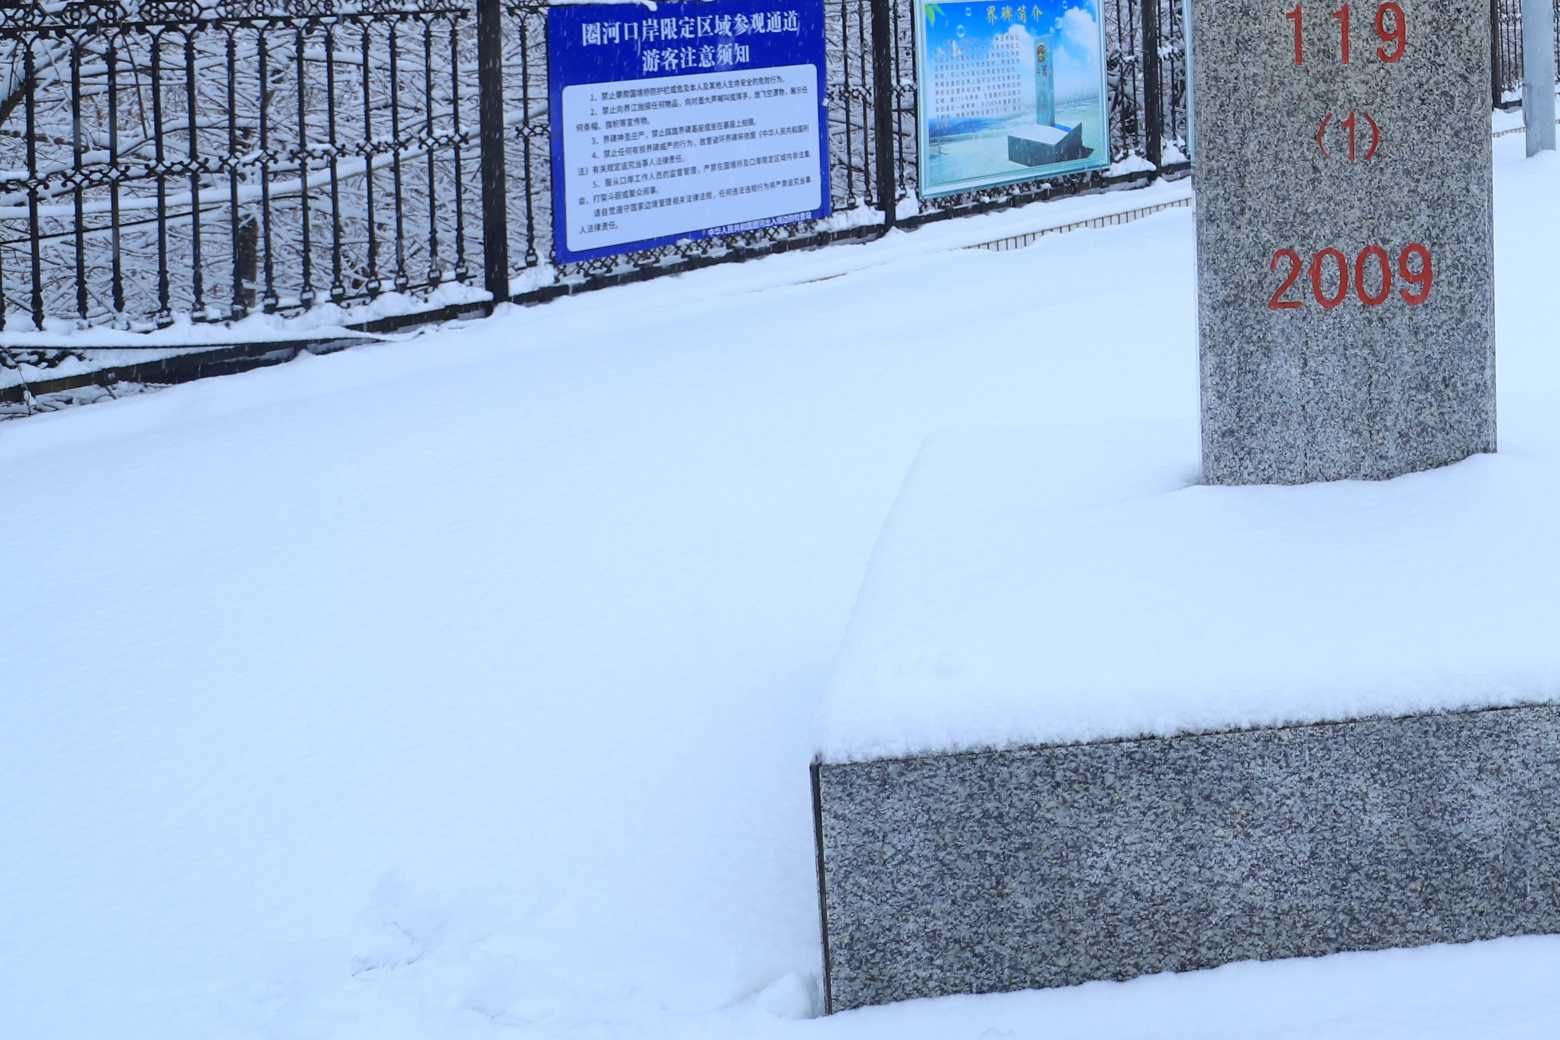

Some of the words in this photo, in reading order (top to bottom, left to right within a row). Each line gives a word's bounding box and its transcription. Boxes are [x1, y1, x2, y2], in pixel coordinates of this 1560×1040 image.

[582, 10, 799, 47] 圈河口岸限定区域参观通道
[1285, 1, 1406, 65] 119
[642, 43, 750, 73] 游客注意须知
[1316, 112, 1381, 161] (1)
[1267, 243, 1433, 310] 2009
